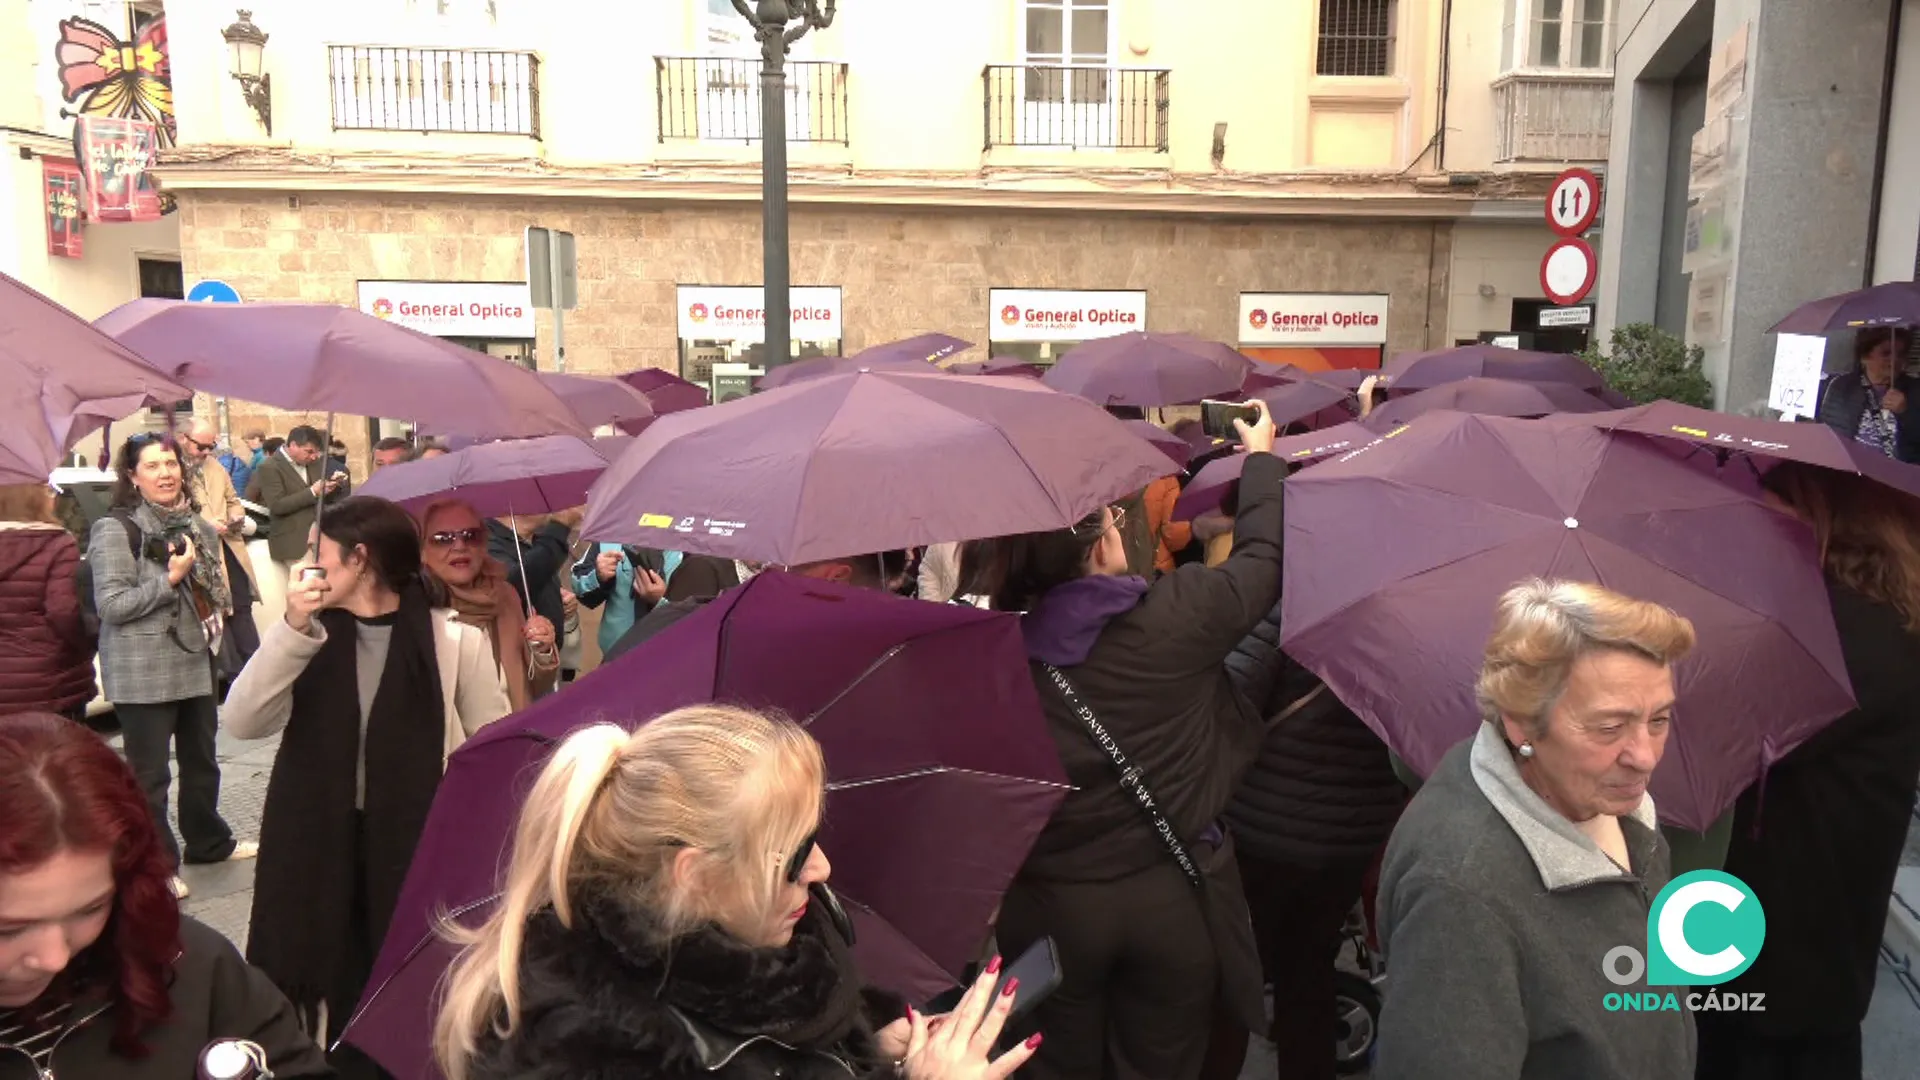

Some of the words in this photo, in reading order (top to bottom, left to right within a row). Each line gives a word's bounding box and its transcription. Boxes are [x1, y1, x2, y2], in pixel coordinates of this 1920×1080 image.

[399, 301, 464, 317] General
[469, 303, 523, 320] Optica
[714, 304, 766, 320] Genera
[788, 306, 831, 322] ptica
[1025, 308, 1084, 322] General
[1088, 309, 1136, 325] Optica
[1271, 311, 1328, 325] General
[1332, 311, 1379, 328] Optica
[1077, 705, 1126, 765] EXCHANGE
